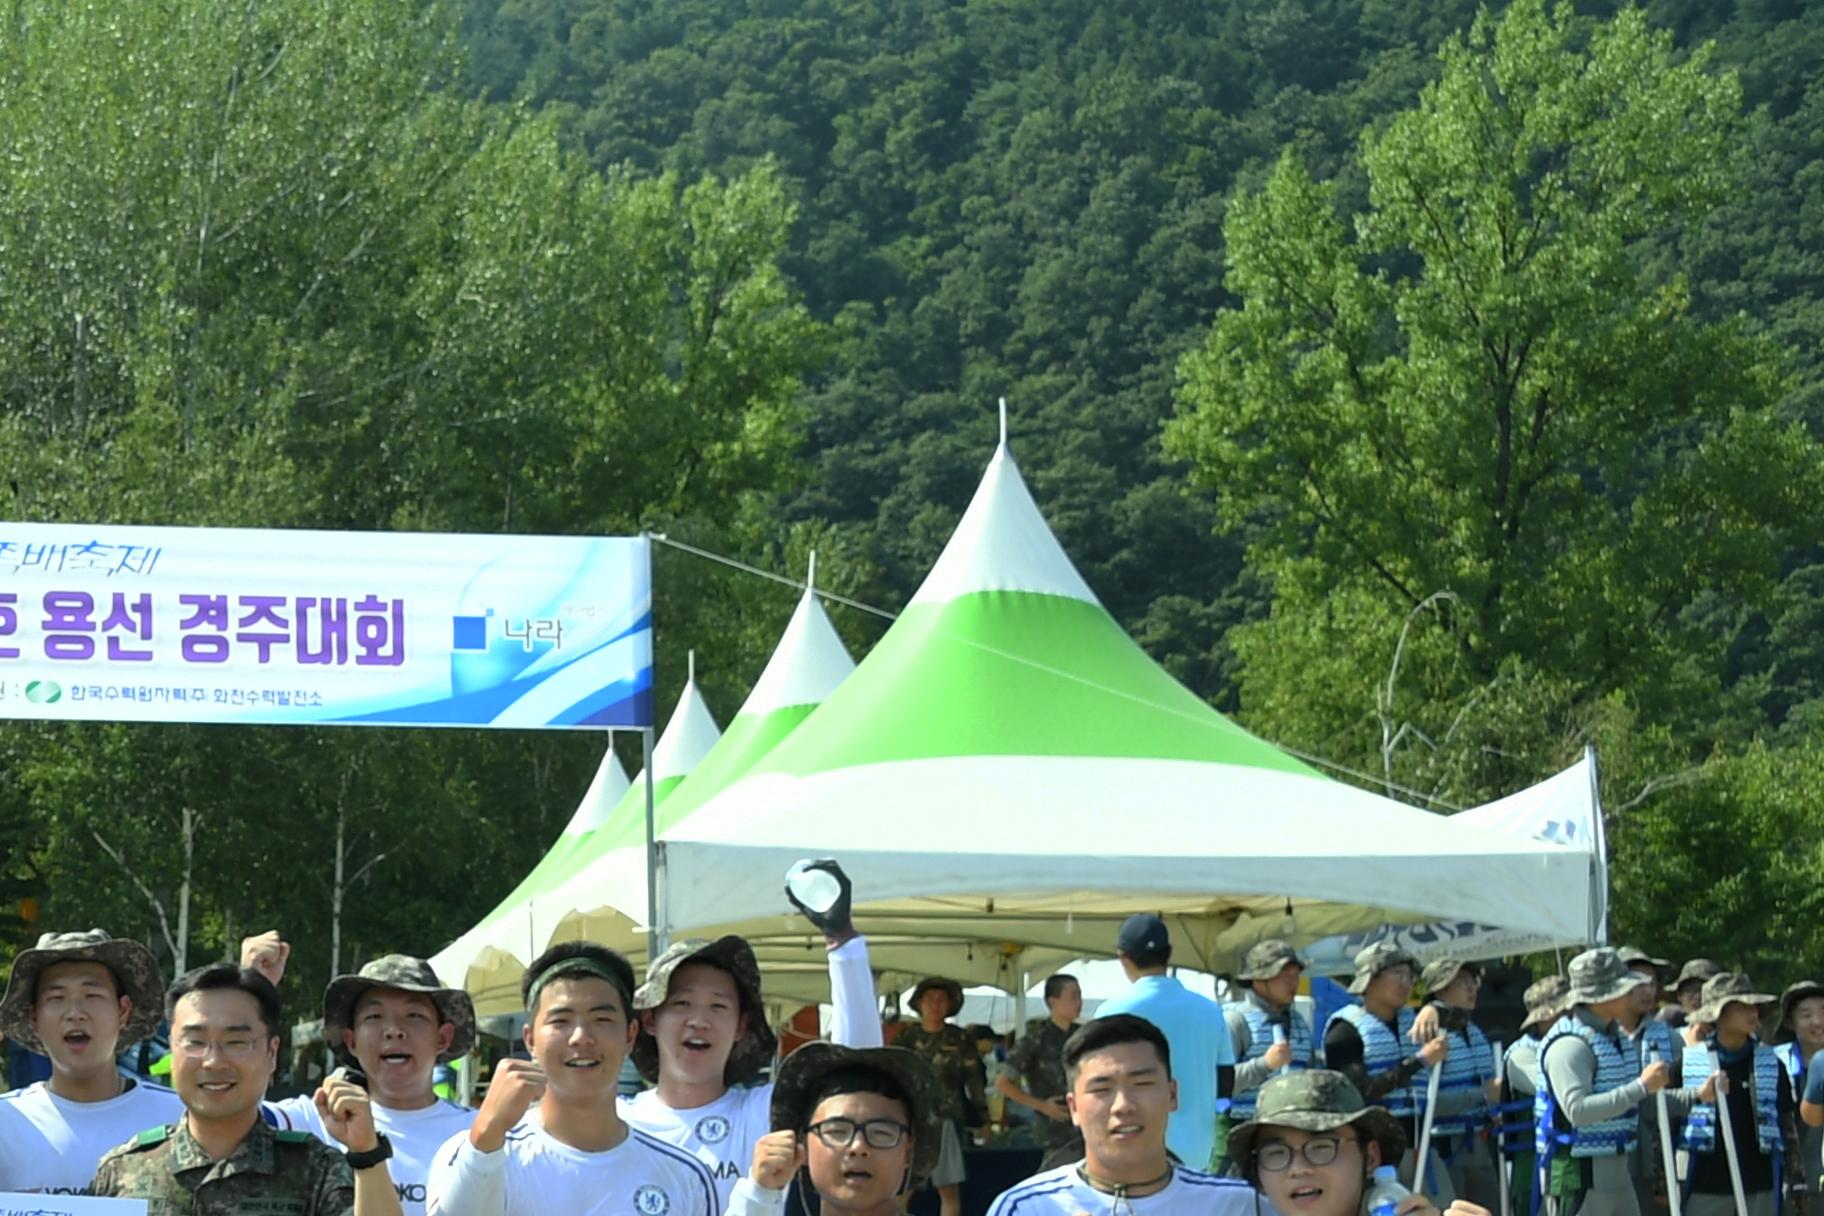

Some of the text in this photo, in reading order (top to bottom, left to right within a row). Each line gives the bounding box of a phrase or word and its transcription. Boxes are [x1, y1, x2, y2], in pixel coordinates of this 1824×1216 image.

[42, 588, 154, 662] 용선
[178, 592, 406, 667] 경주대회
[504, 618, 564, 650] 나라
